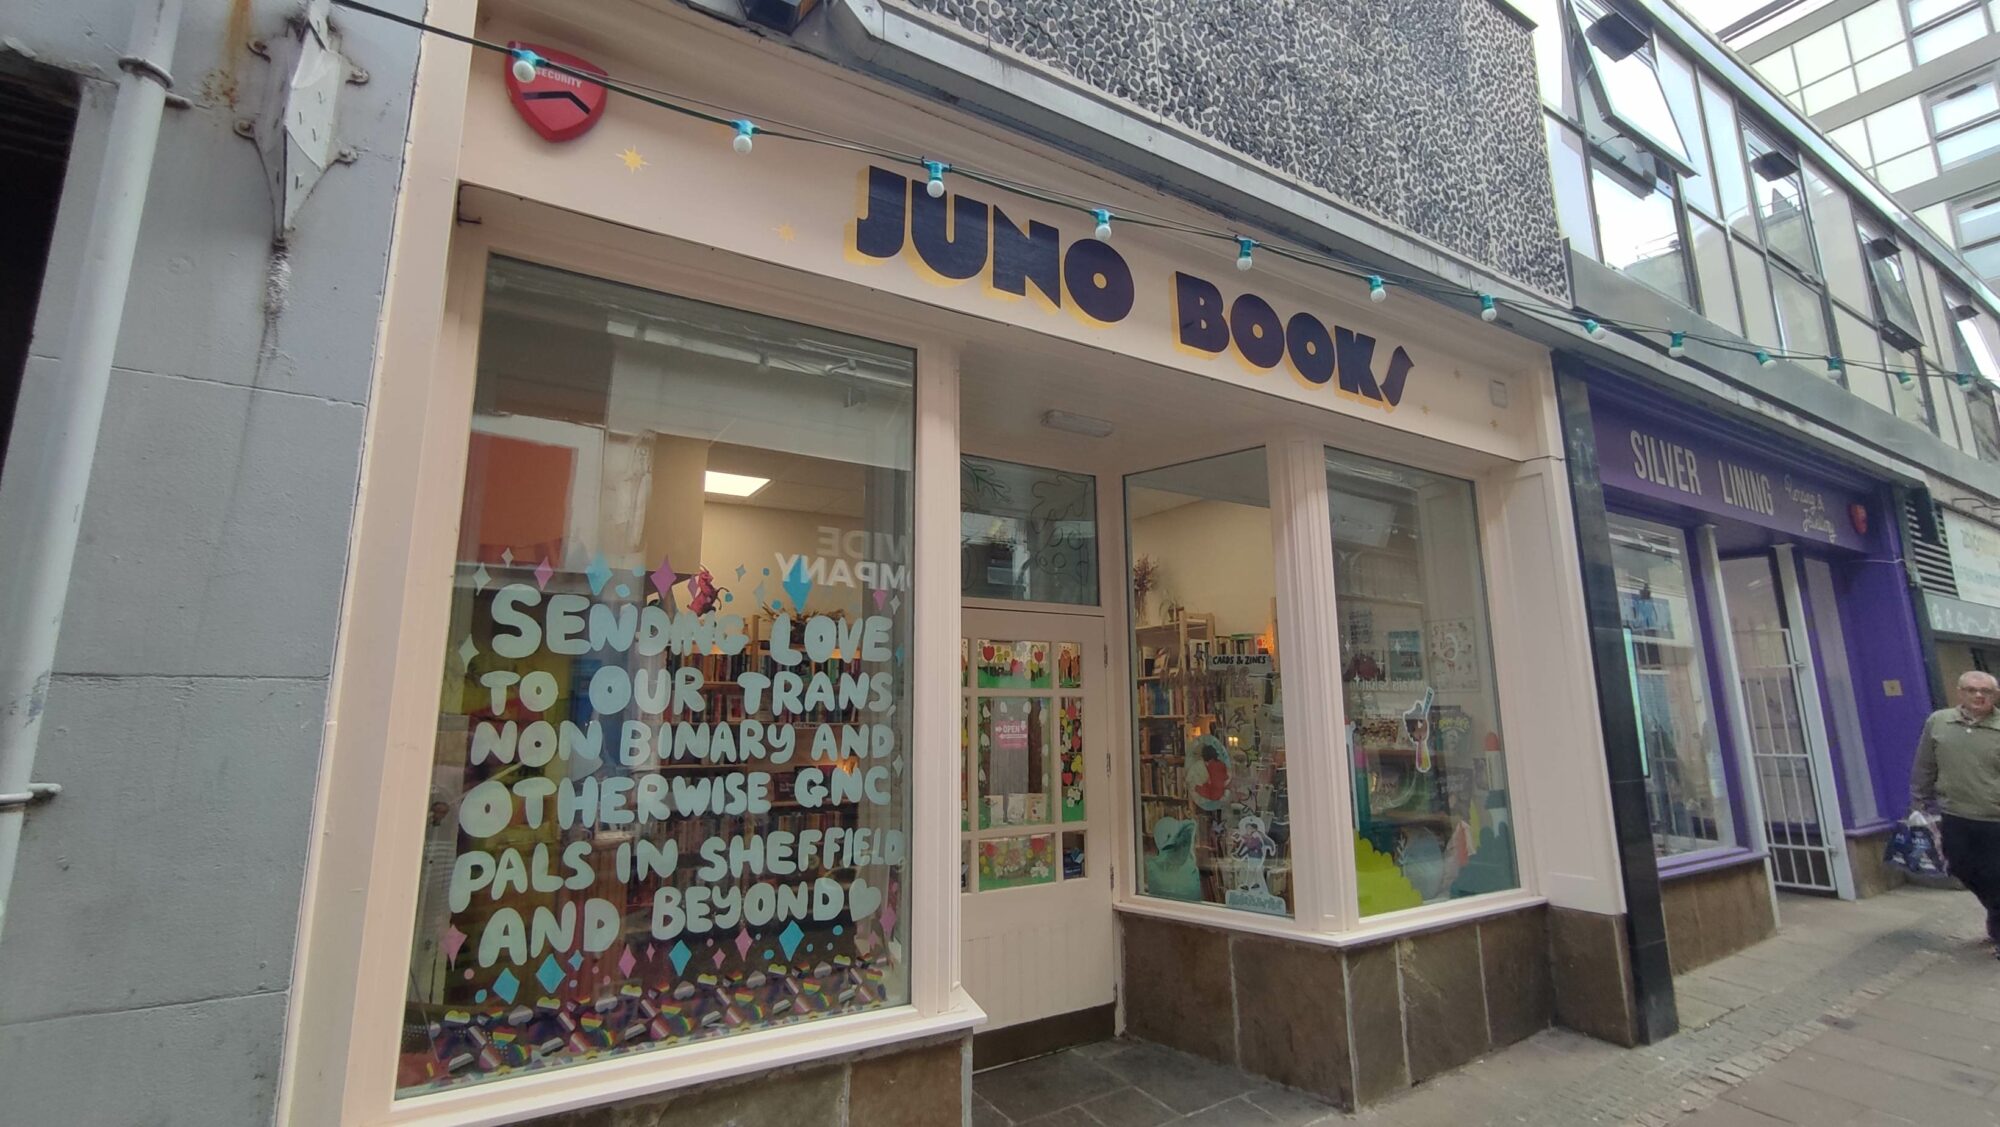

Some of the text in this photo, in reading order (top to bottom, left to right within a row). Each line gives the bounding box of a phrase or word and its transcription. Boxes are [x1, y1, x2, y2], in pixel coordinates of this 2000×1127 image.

[535, 68, 583, 88] SECURITY
[847, 165, 1415, 408] JUNO BOOKS
[1629, 429, 1703, 496] SILVER
[1717, 459, 1775, 517] LINING
[490, 583, 893, 666] SENDING LOVE
[1212, 655, 1235, 665] CARDS
[1245, 655, 1266, 665] ZINES
[480, 670, 559, 716] TO
[588, 665, 706, 715] OUR
[470, 719, 895, 767] NON BINARY AND
[458, 766, 892, 838] OTHERWISE GNC
[448, 827, 904, 914] PALS IN SHEFFIELD
[478, 877, 845, 968] AND BEYOND
